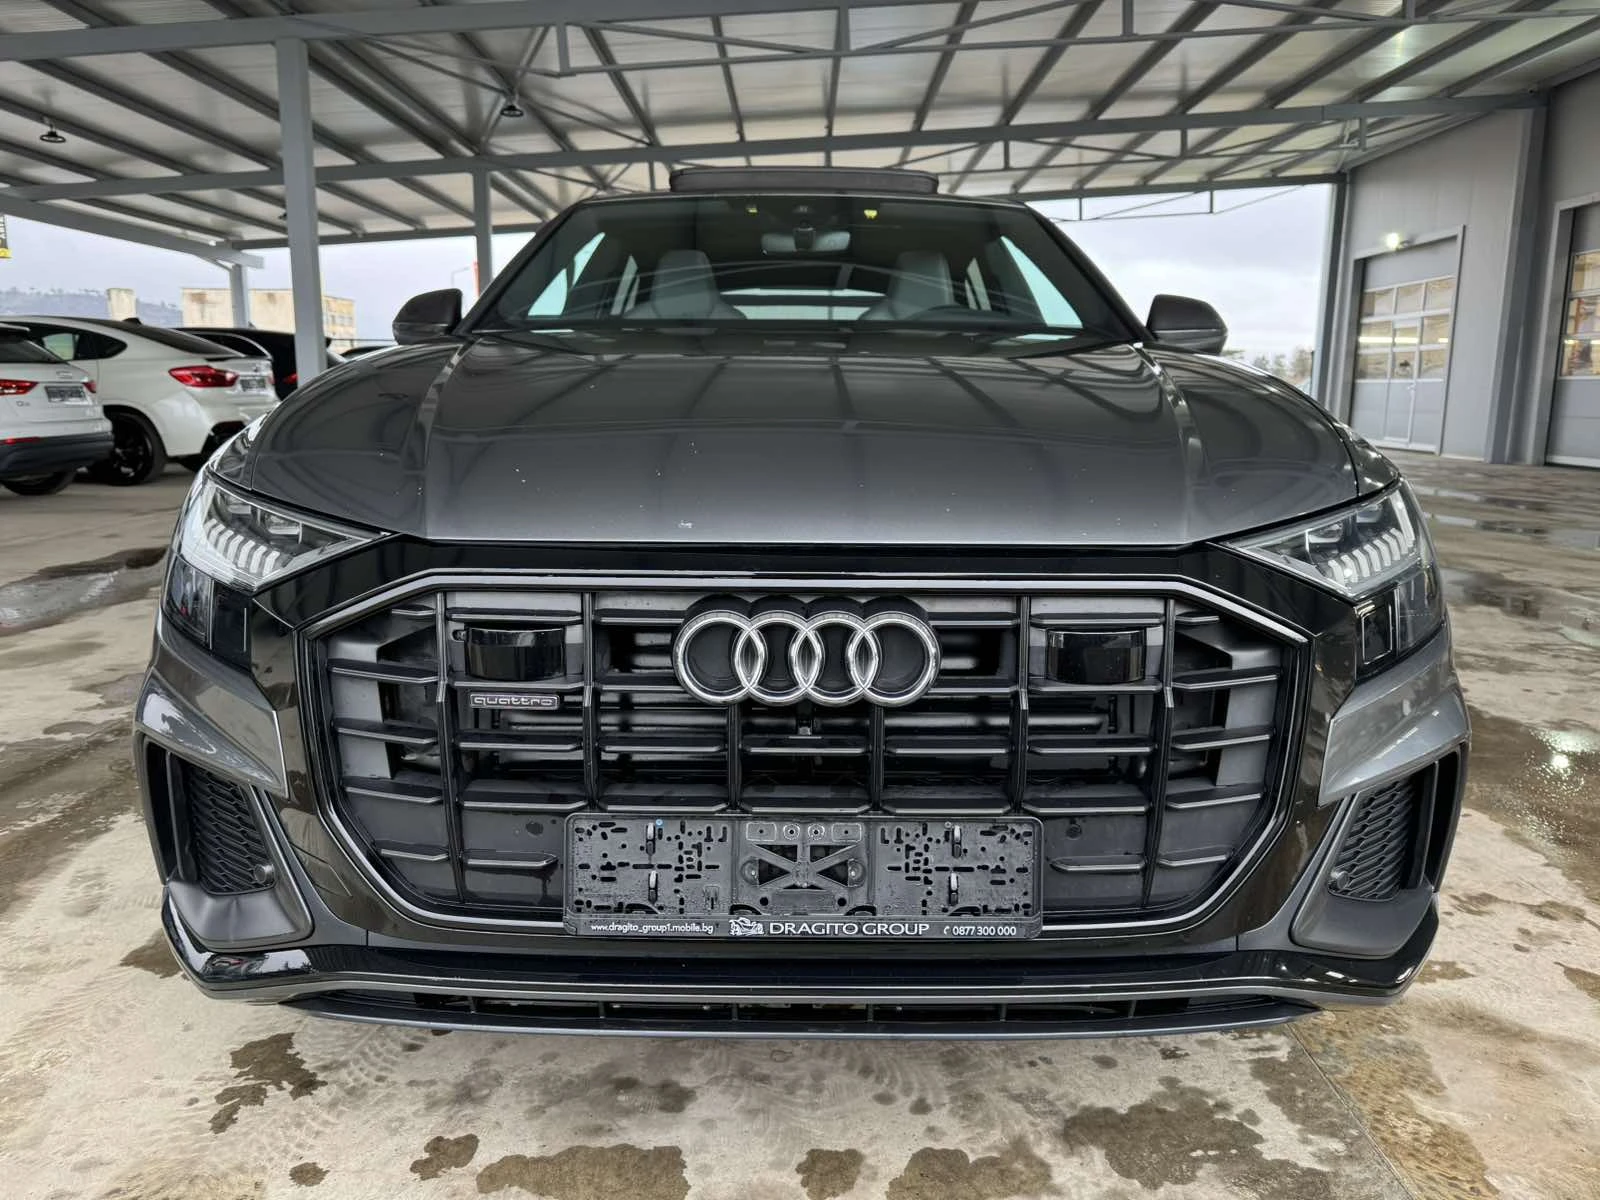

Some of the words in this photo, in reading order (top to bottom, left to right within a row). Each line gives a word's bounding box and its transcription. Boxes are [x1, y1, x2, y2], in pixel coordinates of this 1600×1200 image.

[474, 696, 553, 706] quattro
[591, 922, 713, 934] www.dragito_group1.mobile.bg
[770, 922, 857, 935] DRAGITO
[862, 923, 929, 935] GROUP
[952, 925, 976, 936] 0877
[977, 926, 996, 936] 300
[997, 926, 1017, 936] 000
